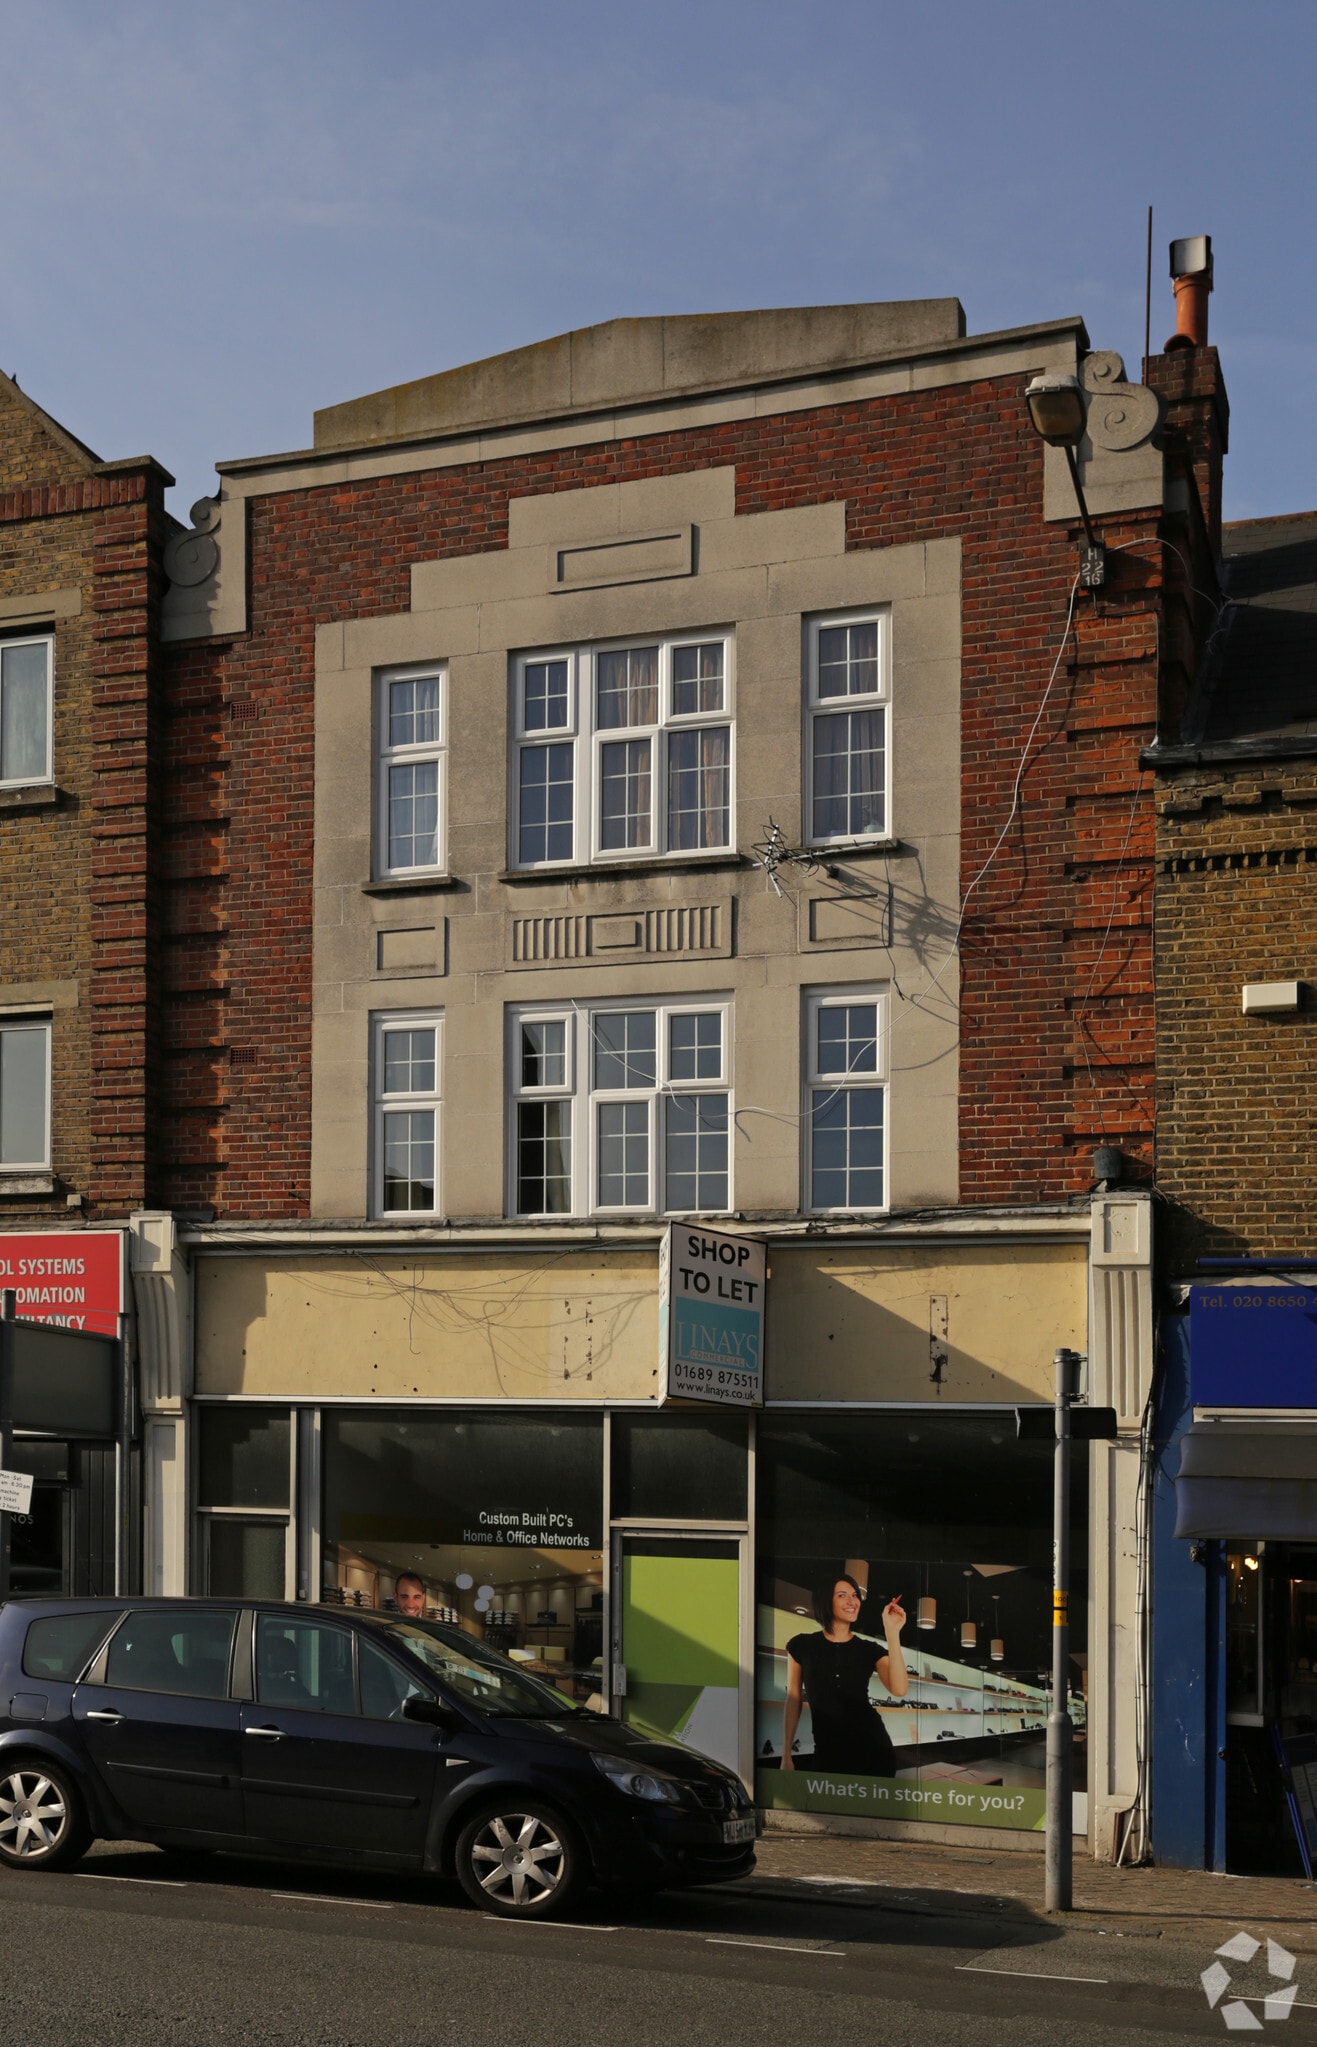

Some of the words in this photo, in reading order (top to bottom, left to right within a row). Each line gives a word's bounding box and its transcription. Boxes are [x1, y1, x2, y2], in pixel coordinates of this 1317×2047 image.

[688, 1235, 750, 1267] SHOP
[19, 1258, 85, 1275] SYSTEMS
[679, 1267, 711, 1294] TO
[718, 1276, 758, 1303] LET
[1200, 1296, 1227, 1308] Tel.
[1232, 1296, 1262, 1308] 020
[1267, 1296, 1307, 1308] 8650
[676, 1321, 758, 1369] LINAYS
[691, 1350, 744, 1367] COMMERCIAL
[674, 1363, 713, 1381] 01689
[718, 1370, 759, 1389] 875511
[676, 1381, 756, 1400] www.linays.co.uk
[479, 1511, 519, 1525] Custom
[522, 1513, 547, 1526] Built
[550, 1514, 574, 1528] PC's
[463, 1529, 493, 1542] Home
[496, 1530, 503, 1543] &
[507, 1530, 538, 1545] Office
[540, 1532, 590, 1547] Networks
[807, 1779, 867, 1798] What's
[873, 1784, 889, 1800] in
[895, 1787, 943, 1805] store
[948, 1789, 975, 1807] for
[980, 1794, 1025, 1812] you?
